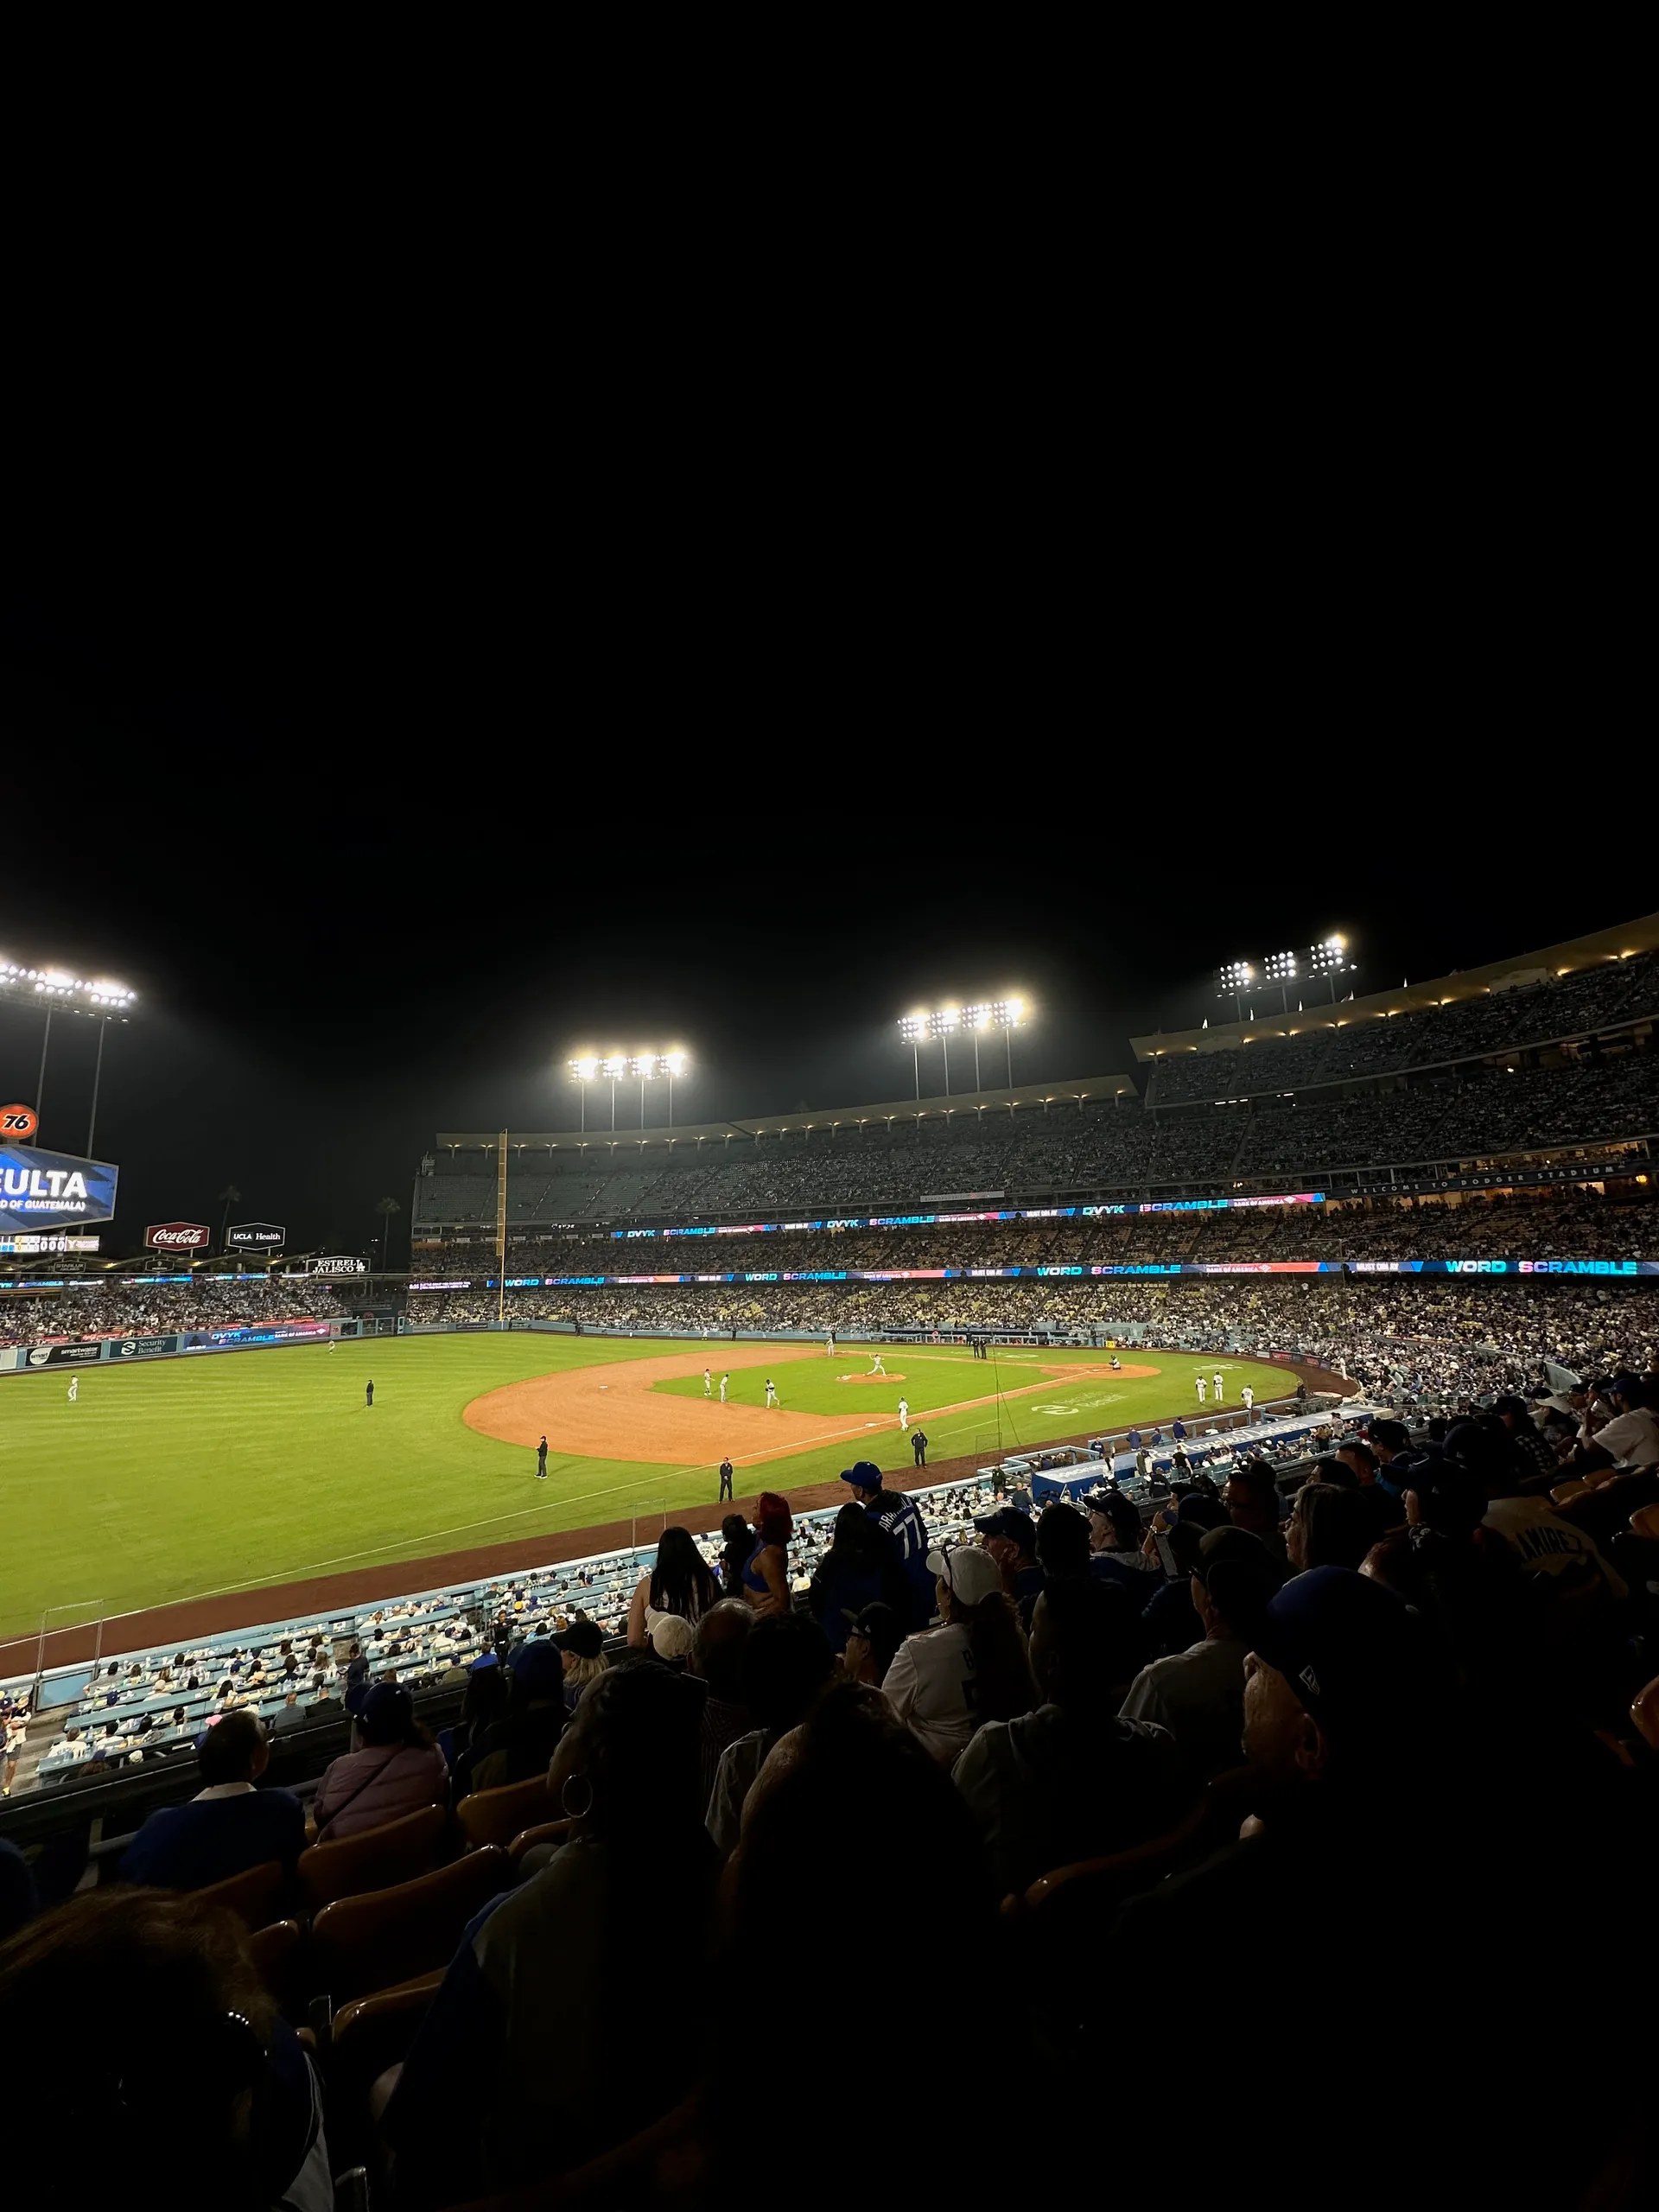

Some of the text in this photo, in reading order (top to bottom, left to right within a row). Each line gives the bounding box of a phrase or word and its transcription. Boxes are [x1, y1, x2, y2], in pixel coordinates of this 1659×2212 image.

[2, 1114, 30, 1130] 76
[1351, 1183, 1421, 1195] WELCOME
[1461, 1174, 1524, 1185] DODGER
[1537, 1166, 1614, 1179] STADIUM
[10, 1200, 24, 1209] OF
[25, 1201, 86, 1211] GUATEMALA)
[1083, 1199, 1228, 1216] DVYK SCRAMBLE
[827, 1216, 935, 1228] DVYK SCRAMBLE
[152, 1229, 204, 1243] Coca-Cola
[1037, 1264, 1182, 1276] WORD SCRAMBLE
[1446, 1261, 1638, 1274] WORD SCRAMBLE
[745, 1272, 847, 1281] WORD SCRAMBLE
[211, 1332, 241, 1340] DVYK
[893, 1512, 922, 1560] 77
